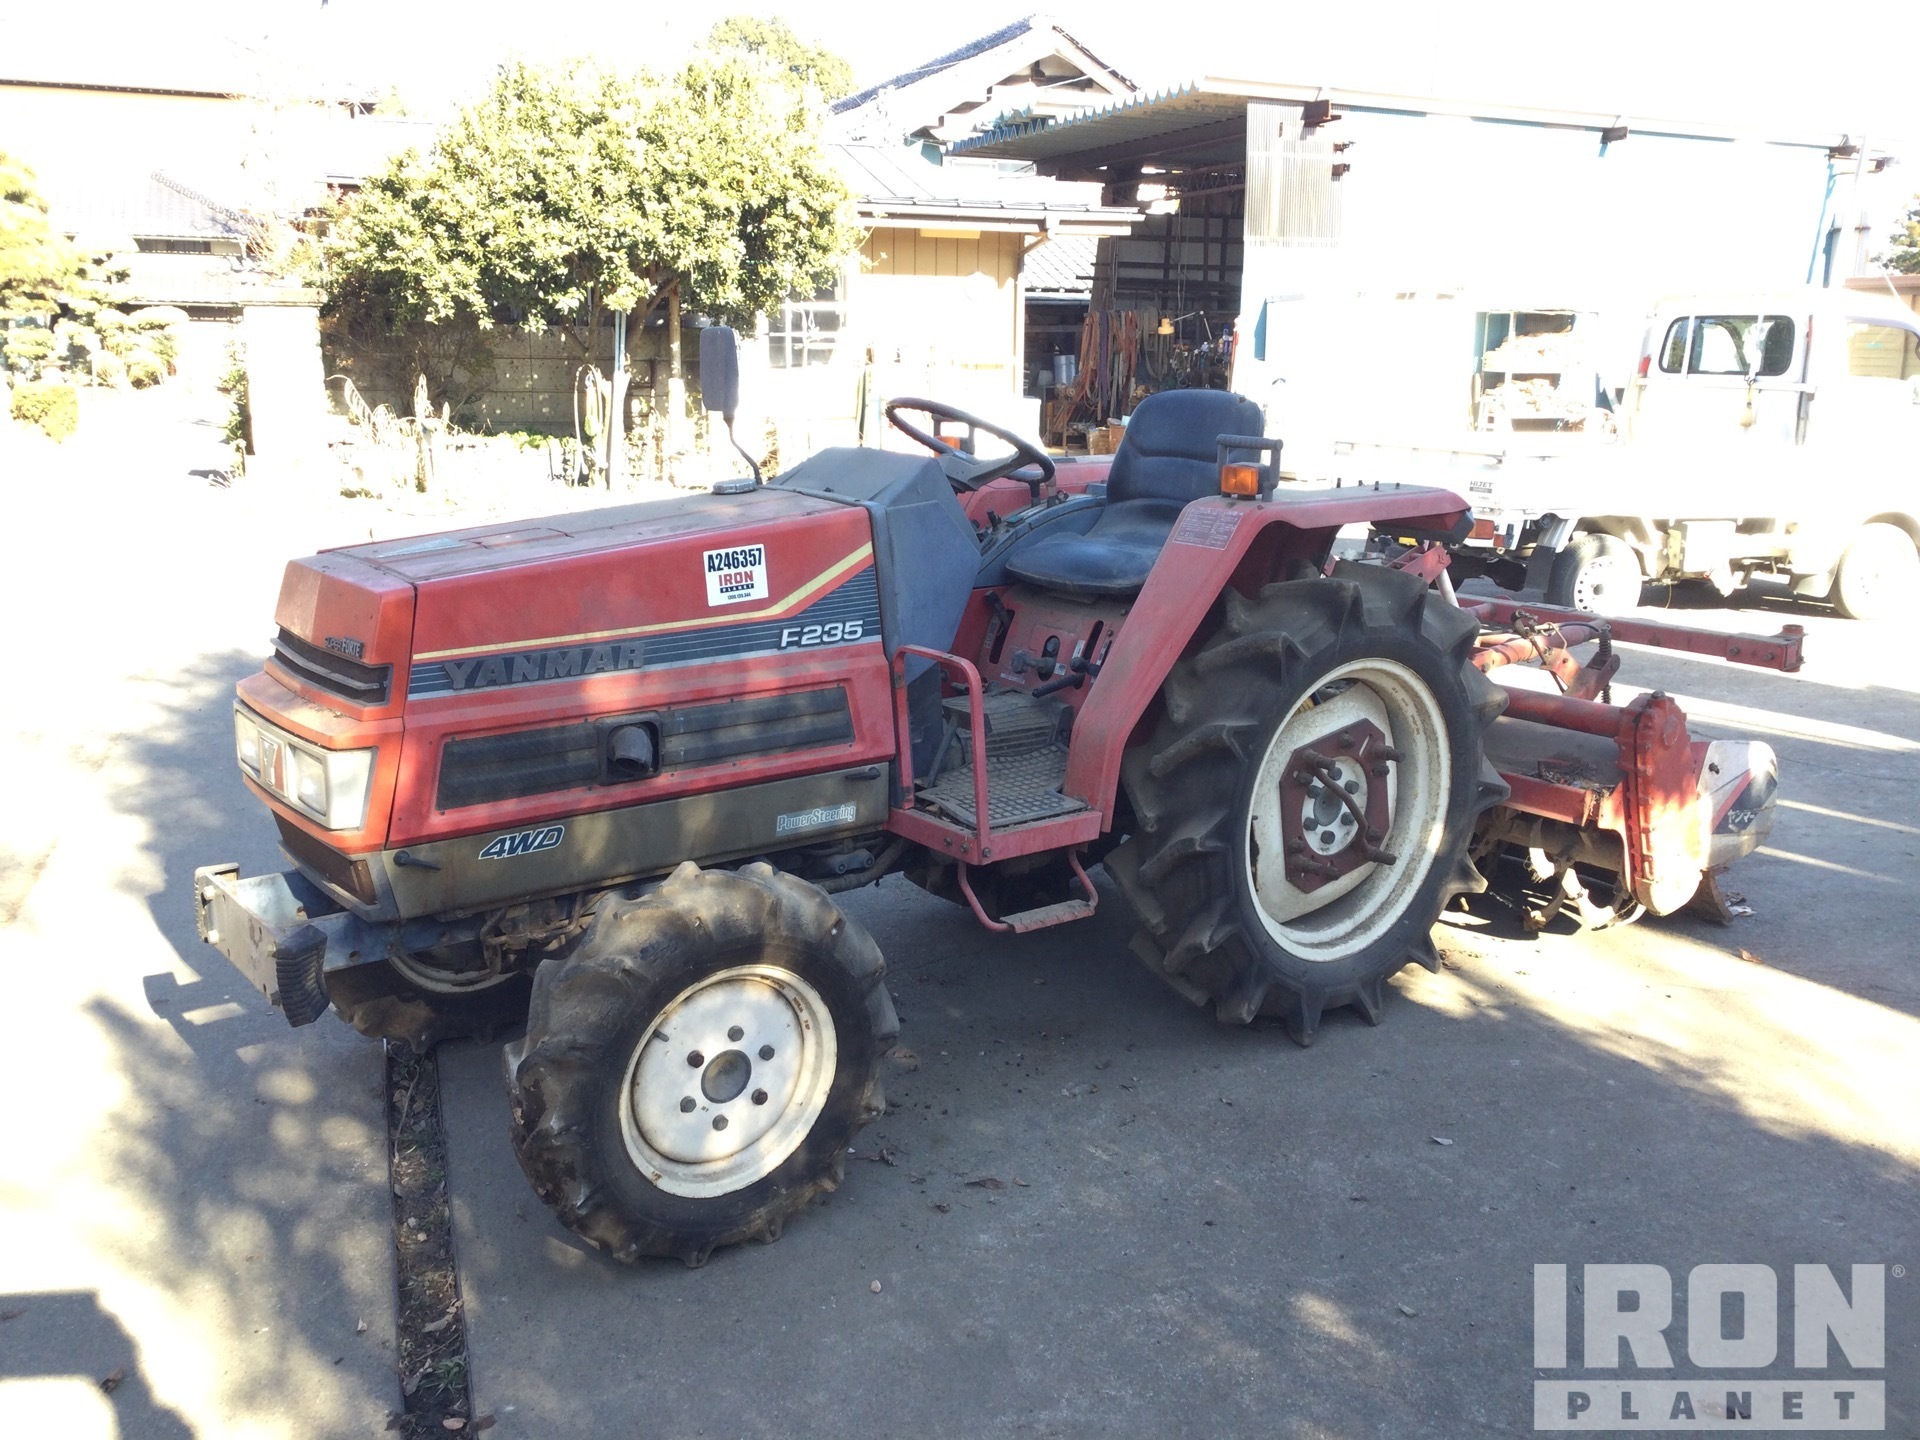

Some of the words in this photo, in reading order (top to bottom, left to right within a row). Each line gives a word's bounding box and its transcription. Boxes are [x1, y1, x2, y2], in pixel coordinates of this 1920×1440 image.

[708, 548, 762, 573] A246357
[718, 570, 754, 587] IRON
[780, 619, 863, 648] F235
[442, 643, 647, 690] YANMAR
[478, 825, 565, 860] 4WD
